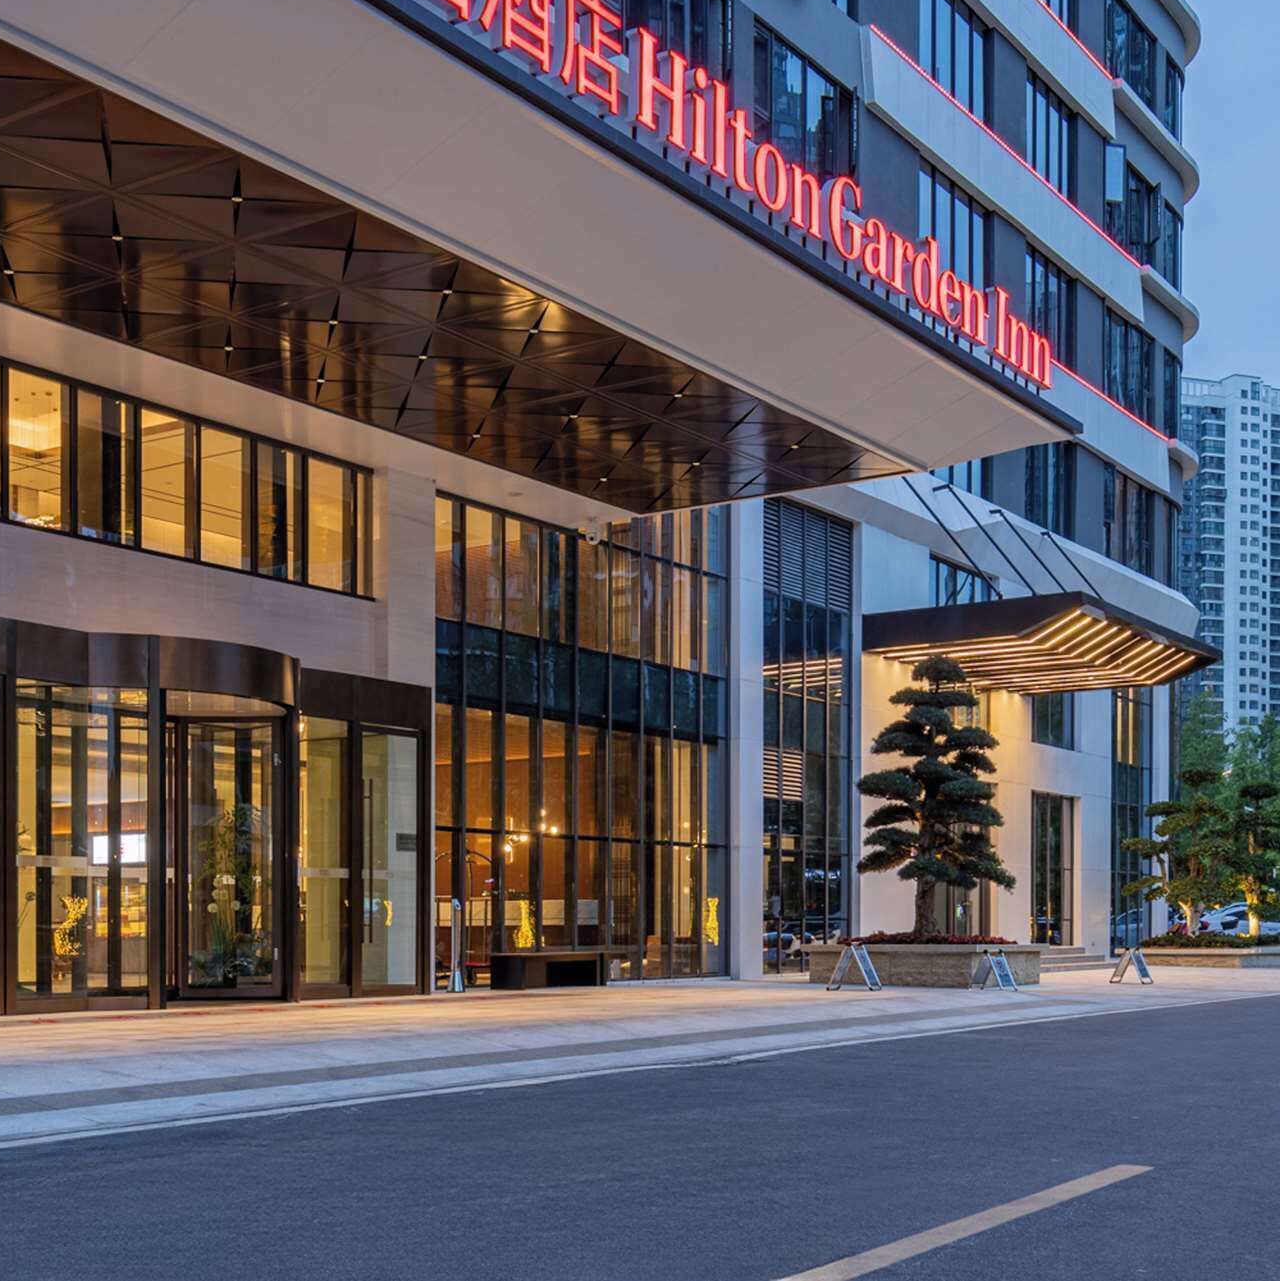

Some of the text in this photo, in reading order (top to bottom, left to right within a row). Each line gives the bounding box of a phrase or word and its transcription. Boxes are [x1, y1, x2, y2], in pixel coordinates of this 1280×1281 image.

[630, 26, 1052, 390] Hilton Garden Inn
